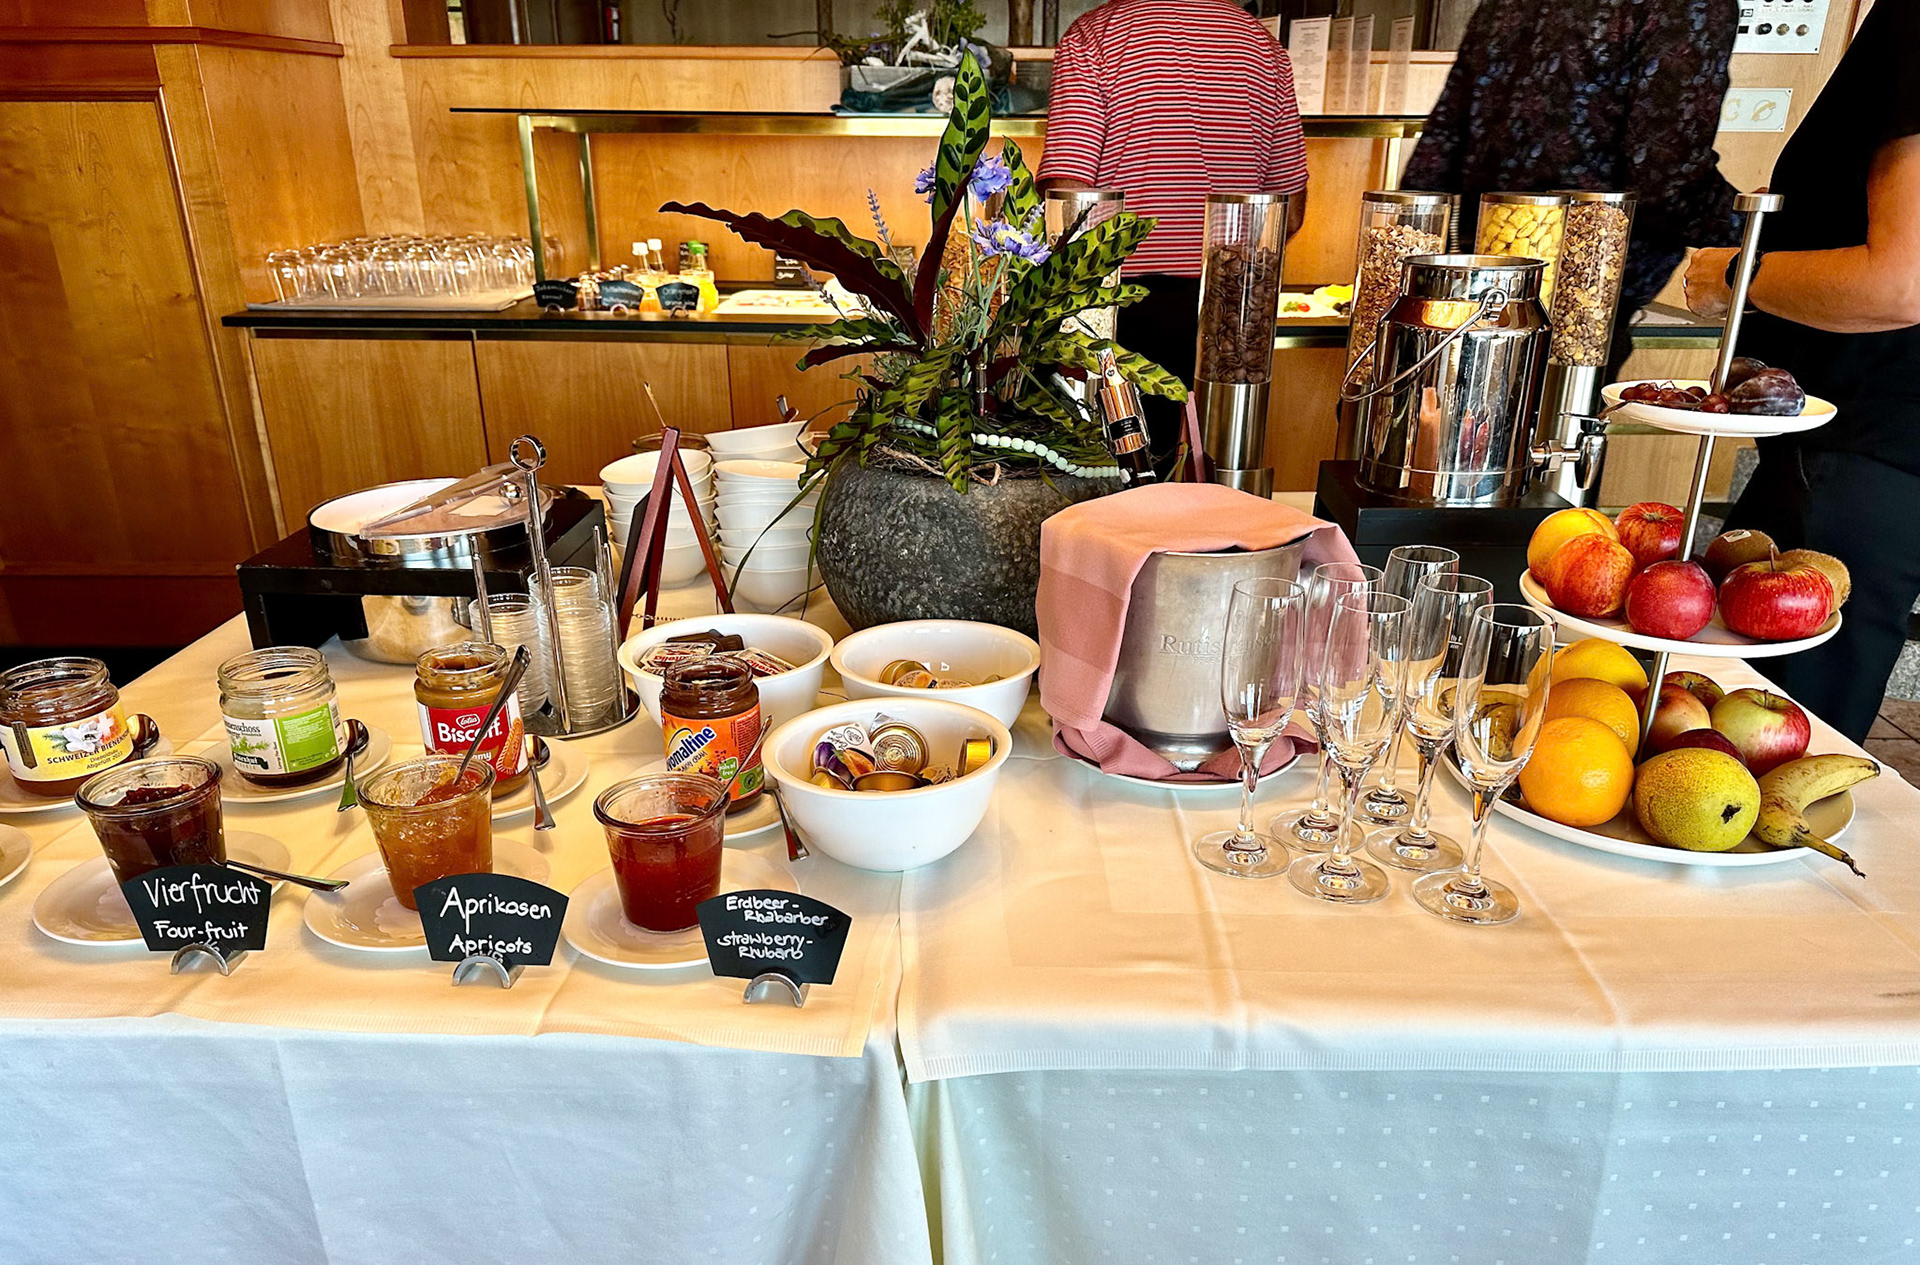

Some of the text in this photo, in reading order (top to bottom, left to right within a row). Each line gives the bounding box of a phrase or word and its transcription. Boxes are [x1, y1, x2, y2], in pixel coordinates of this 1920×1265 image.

[47, 749, 99, 764] SCHWEIZER
[142, 872, 261, 914] Vierfrucht
[439, 886, 552, 935] Aprikosen
[744, 909, 829, 926] Rhabarber
[153, 920, 249, 941] Four-fruit
[448, 934, 533, 958] Apricots
[738, 946, 804, 961] Rhubarb
